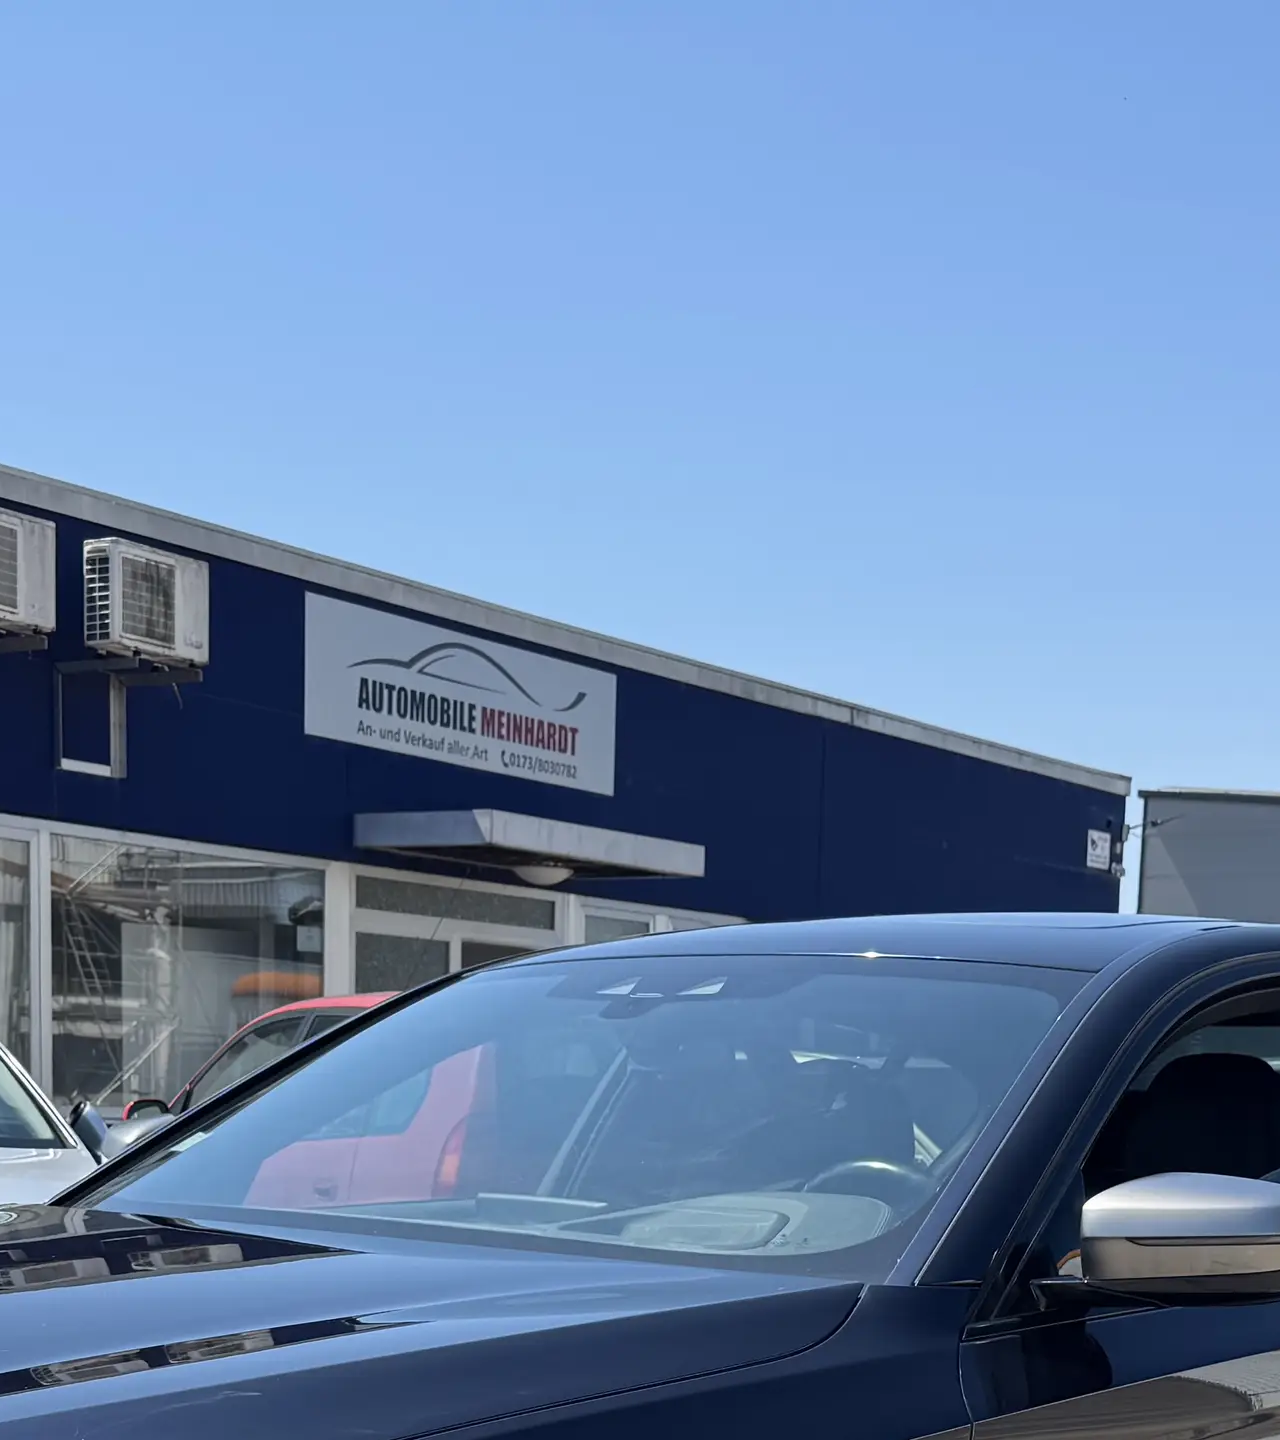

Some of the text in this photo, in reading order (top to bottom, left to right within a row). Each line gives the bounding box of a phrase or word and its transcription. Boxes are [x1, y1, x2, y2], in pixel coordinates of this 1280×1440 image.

[358, 677, 579, 756] AUTOMOBILE MEINHARDT
[357, 720, 488, 762] An- und Verkauf aller Art
[509, 752, 578, 779] 0173/8030782
